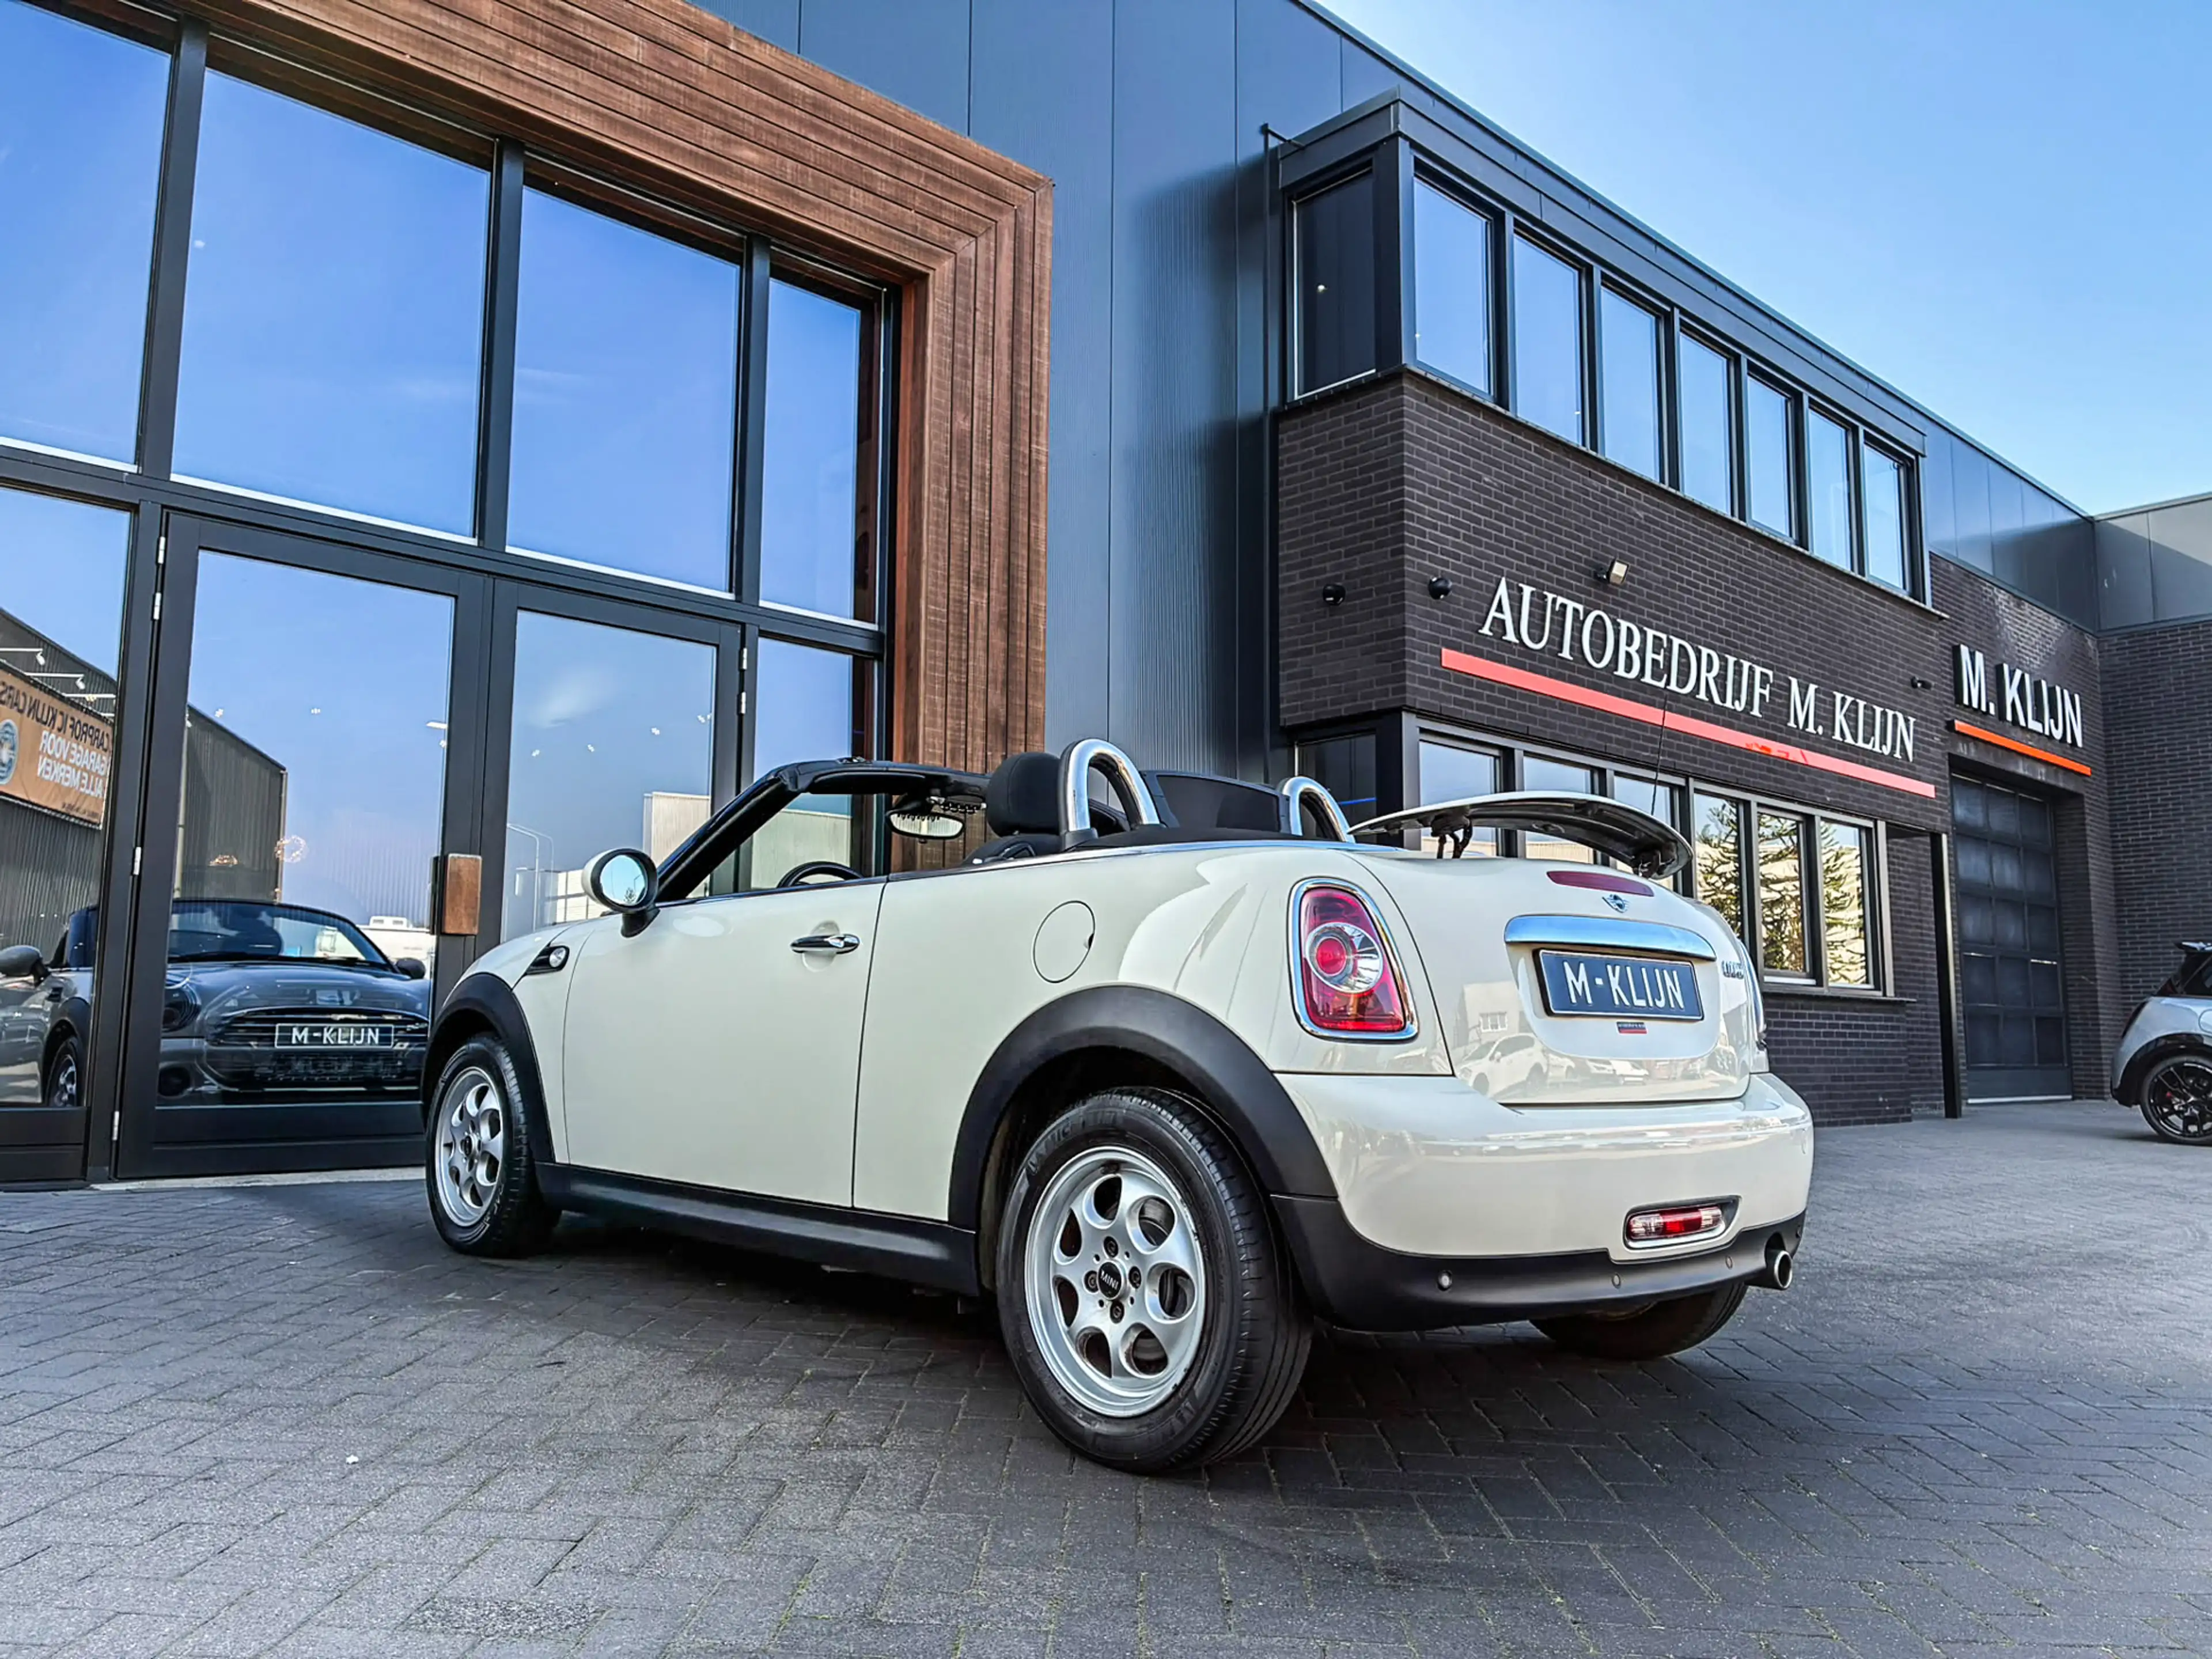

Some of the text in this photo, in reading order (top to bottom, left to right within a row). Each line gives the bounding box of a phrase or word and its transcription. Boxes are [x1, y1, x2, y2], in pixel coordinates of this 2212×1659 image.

[1478, 577, 1916, 762] AUTOBEDRIJF M. KLIJN
[1959, 644, 2083, 747] M. KLIJN
[1100, 1268, 1119, 1290] MINI
